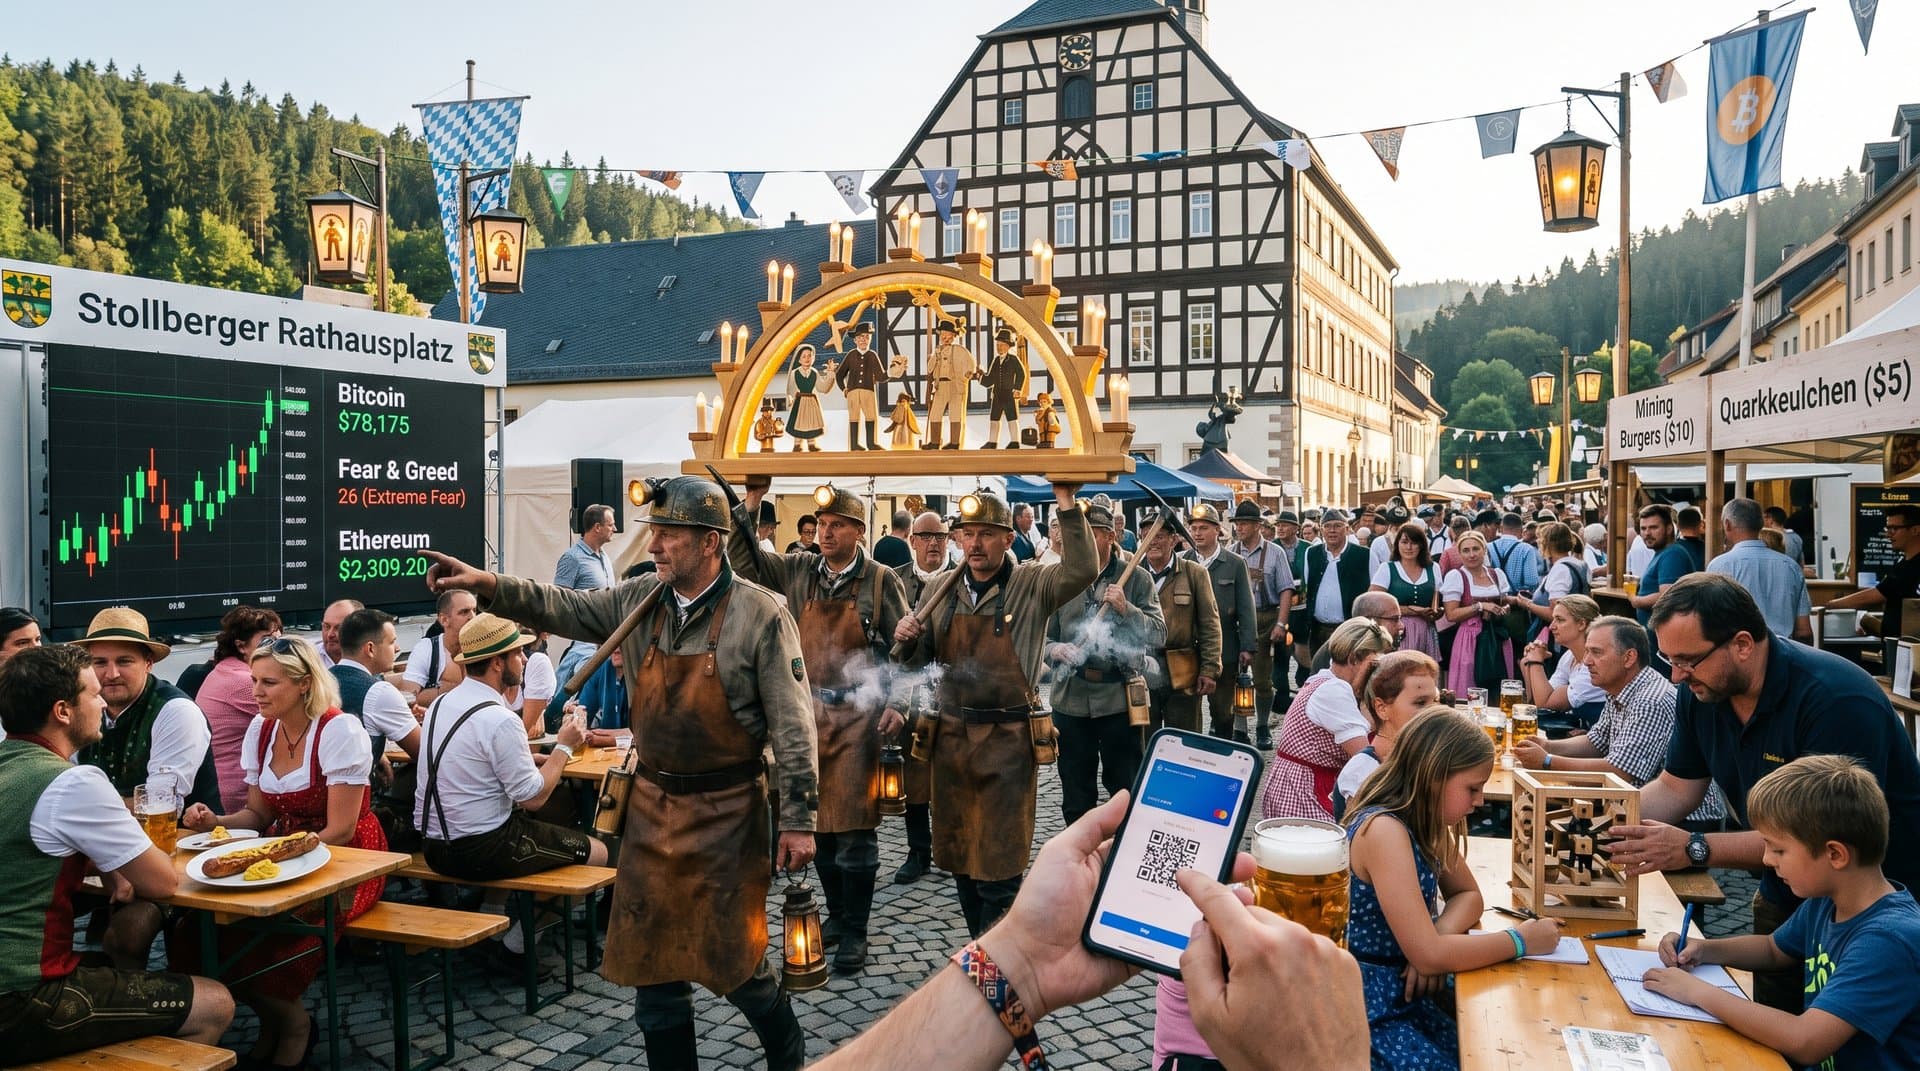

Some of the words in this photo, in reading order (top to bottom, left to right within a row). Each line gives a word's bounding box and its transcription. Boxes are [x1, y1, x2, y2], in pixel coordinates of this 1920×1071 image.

[78, 292, 270, 347] Stollberger
[278, 315, 454, 364] Rathausplatz
[338, 382, 406, 408] Bitcoin
[1720, 377, 1857, 424] Quarkkeulchen
[1864, 359, 1912, 407] ($5)
[1635, 395, 1673, 420] Mining
[338, 410, 410, 435] $78,175
[1620, 429, 1661, 452] Burgers
[1664, 420, 1694, 447] ($10)
[338, 457, 383, 480] Fear
[386, 460, 401, 480] &
[404, 460, 458, 482] Greed
[338, 487, 358, 505] 26
[362, 487, 429, 507] (Extreme
[431, 489, 466, 508] Fear)
[339, 530, 431, 552] Ethereum
[338, 556, 427, 582] $2,309.20
